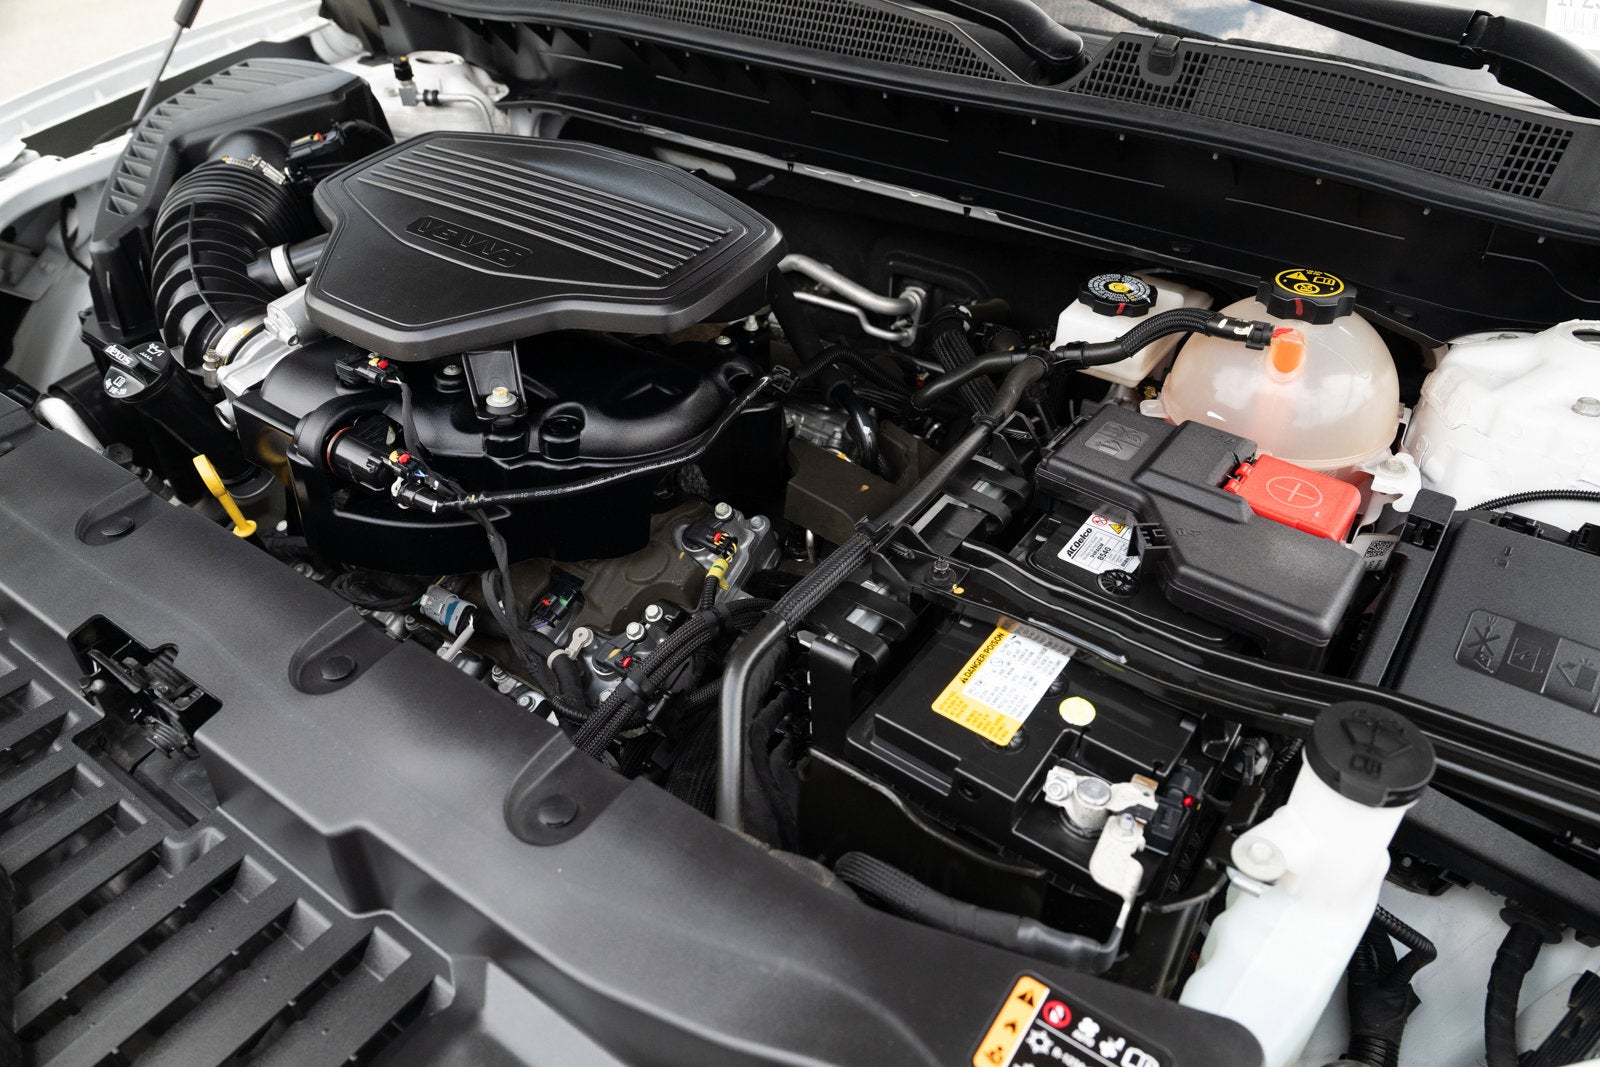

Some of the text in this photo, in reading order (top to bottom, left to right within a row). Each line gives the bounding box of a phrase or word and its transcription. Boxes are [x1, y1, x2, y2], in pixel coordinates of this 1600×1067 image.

[105, 344, 133, 366] dexos
[1066, 527, 1093, 557] ACDelco
[1097, 546, 1111, 560] 8540
[964, 632, 1005, 678] DANGER POISON
